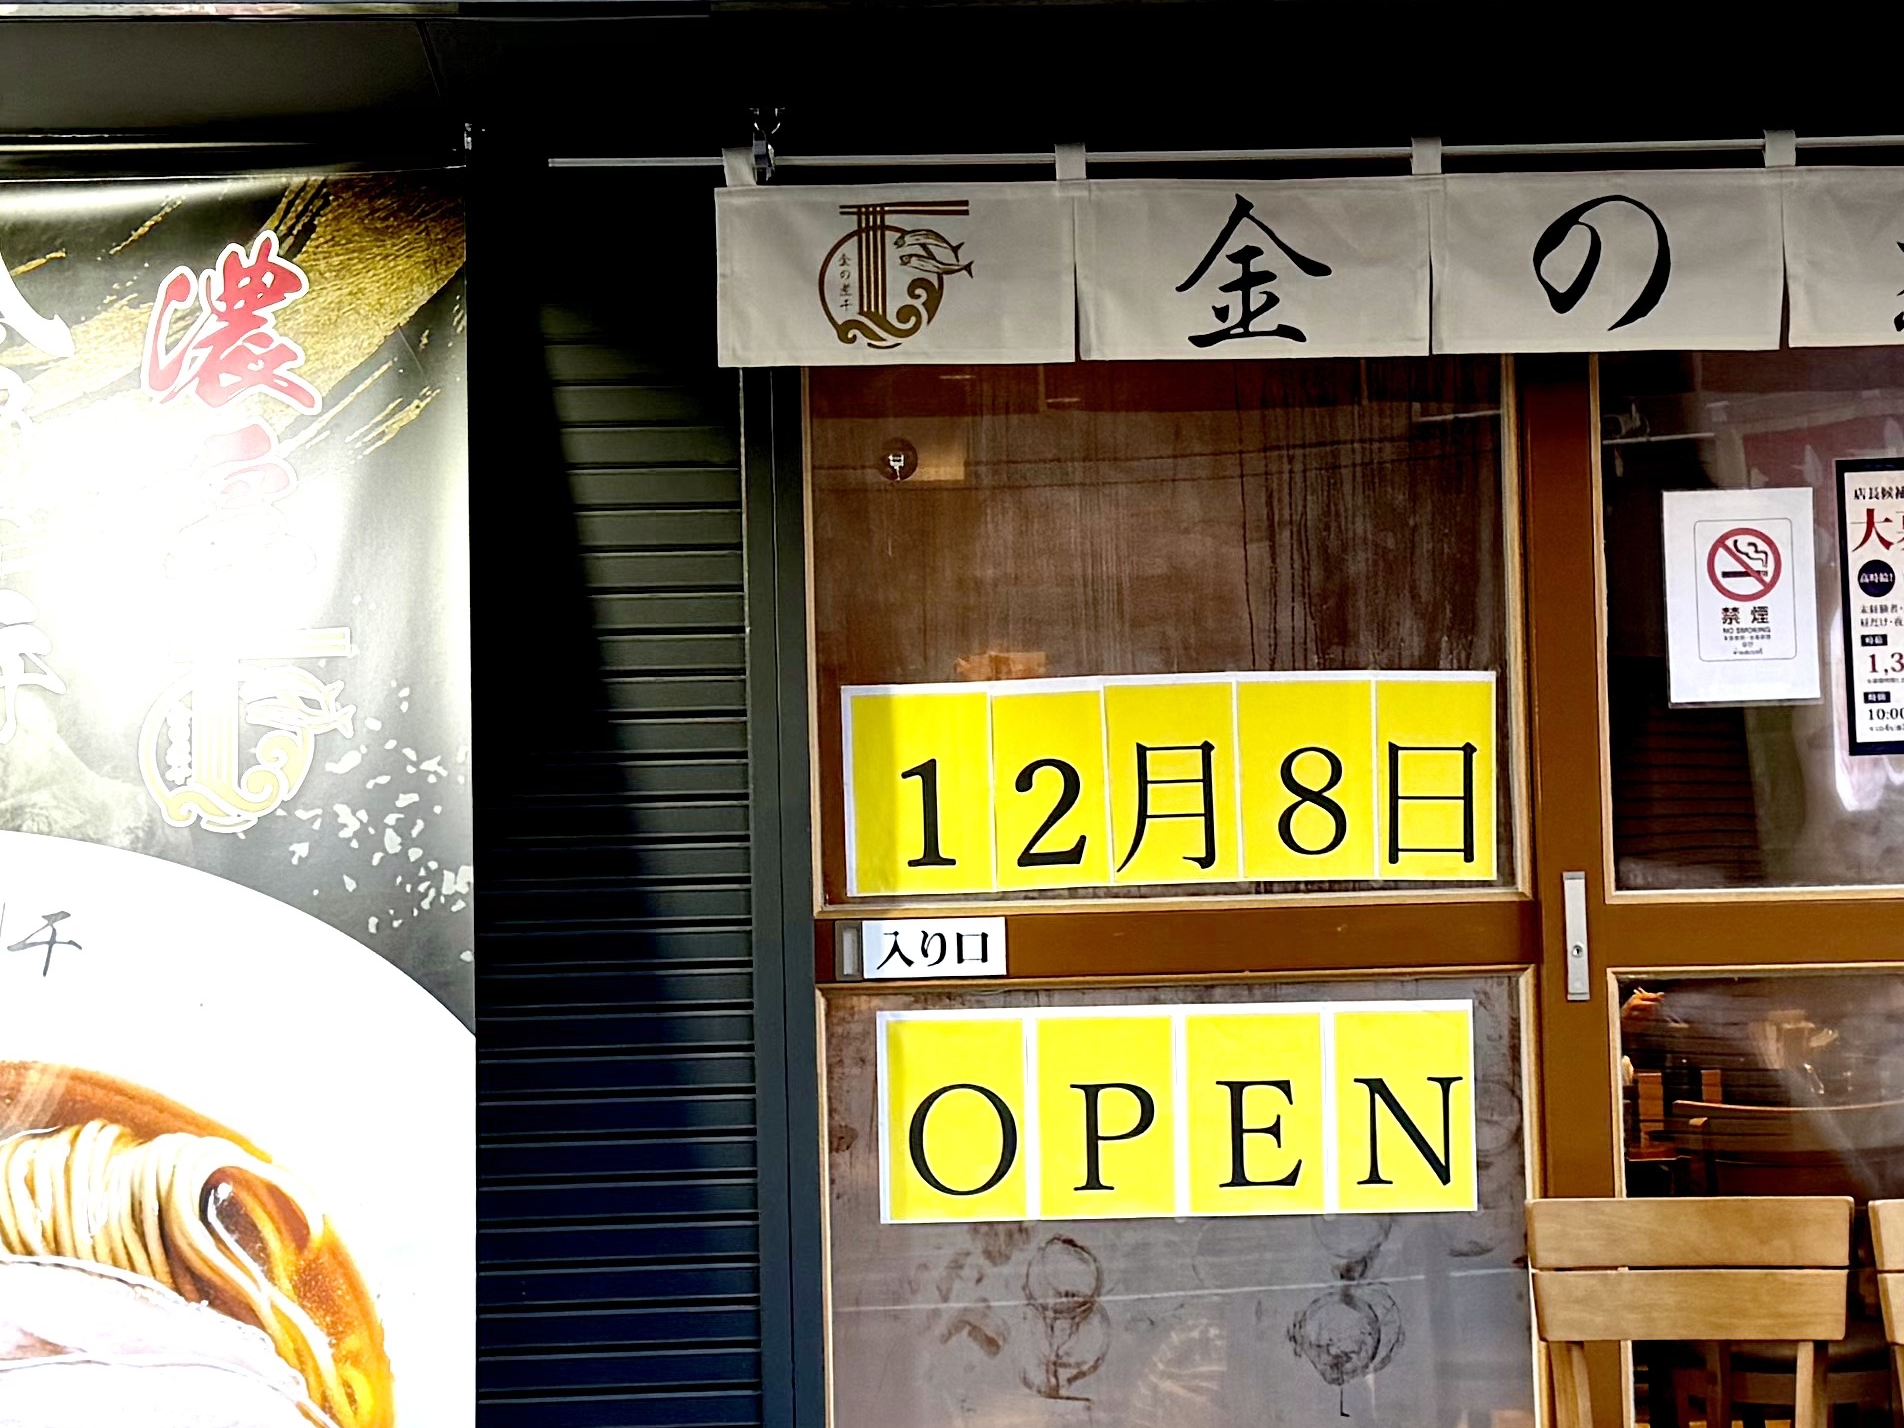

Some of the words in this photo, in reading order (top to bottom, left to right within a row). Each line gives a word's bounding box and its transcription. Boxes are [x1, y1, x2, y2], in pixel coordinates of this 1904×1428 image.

[1721, 606, 1769, 625] 禁煙
[900, 738, 1480, 873] 12月8日
[876, 928, 991, 970] 入り口
[908, 1075, 1464, 1197] OPEN
